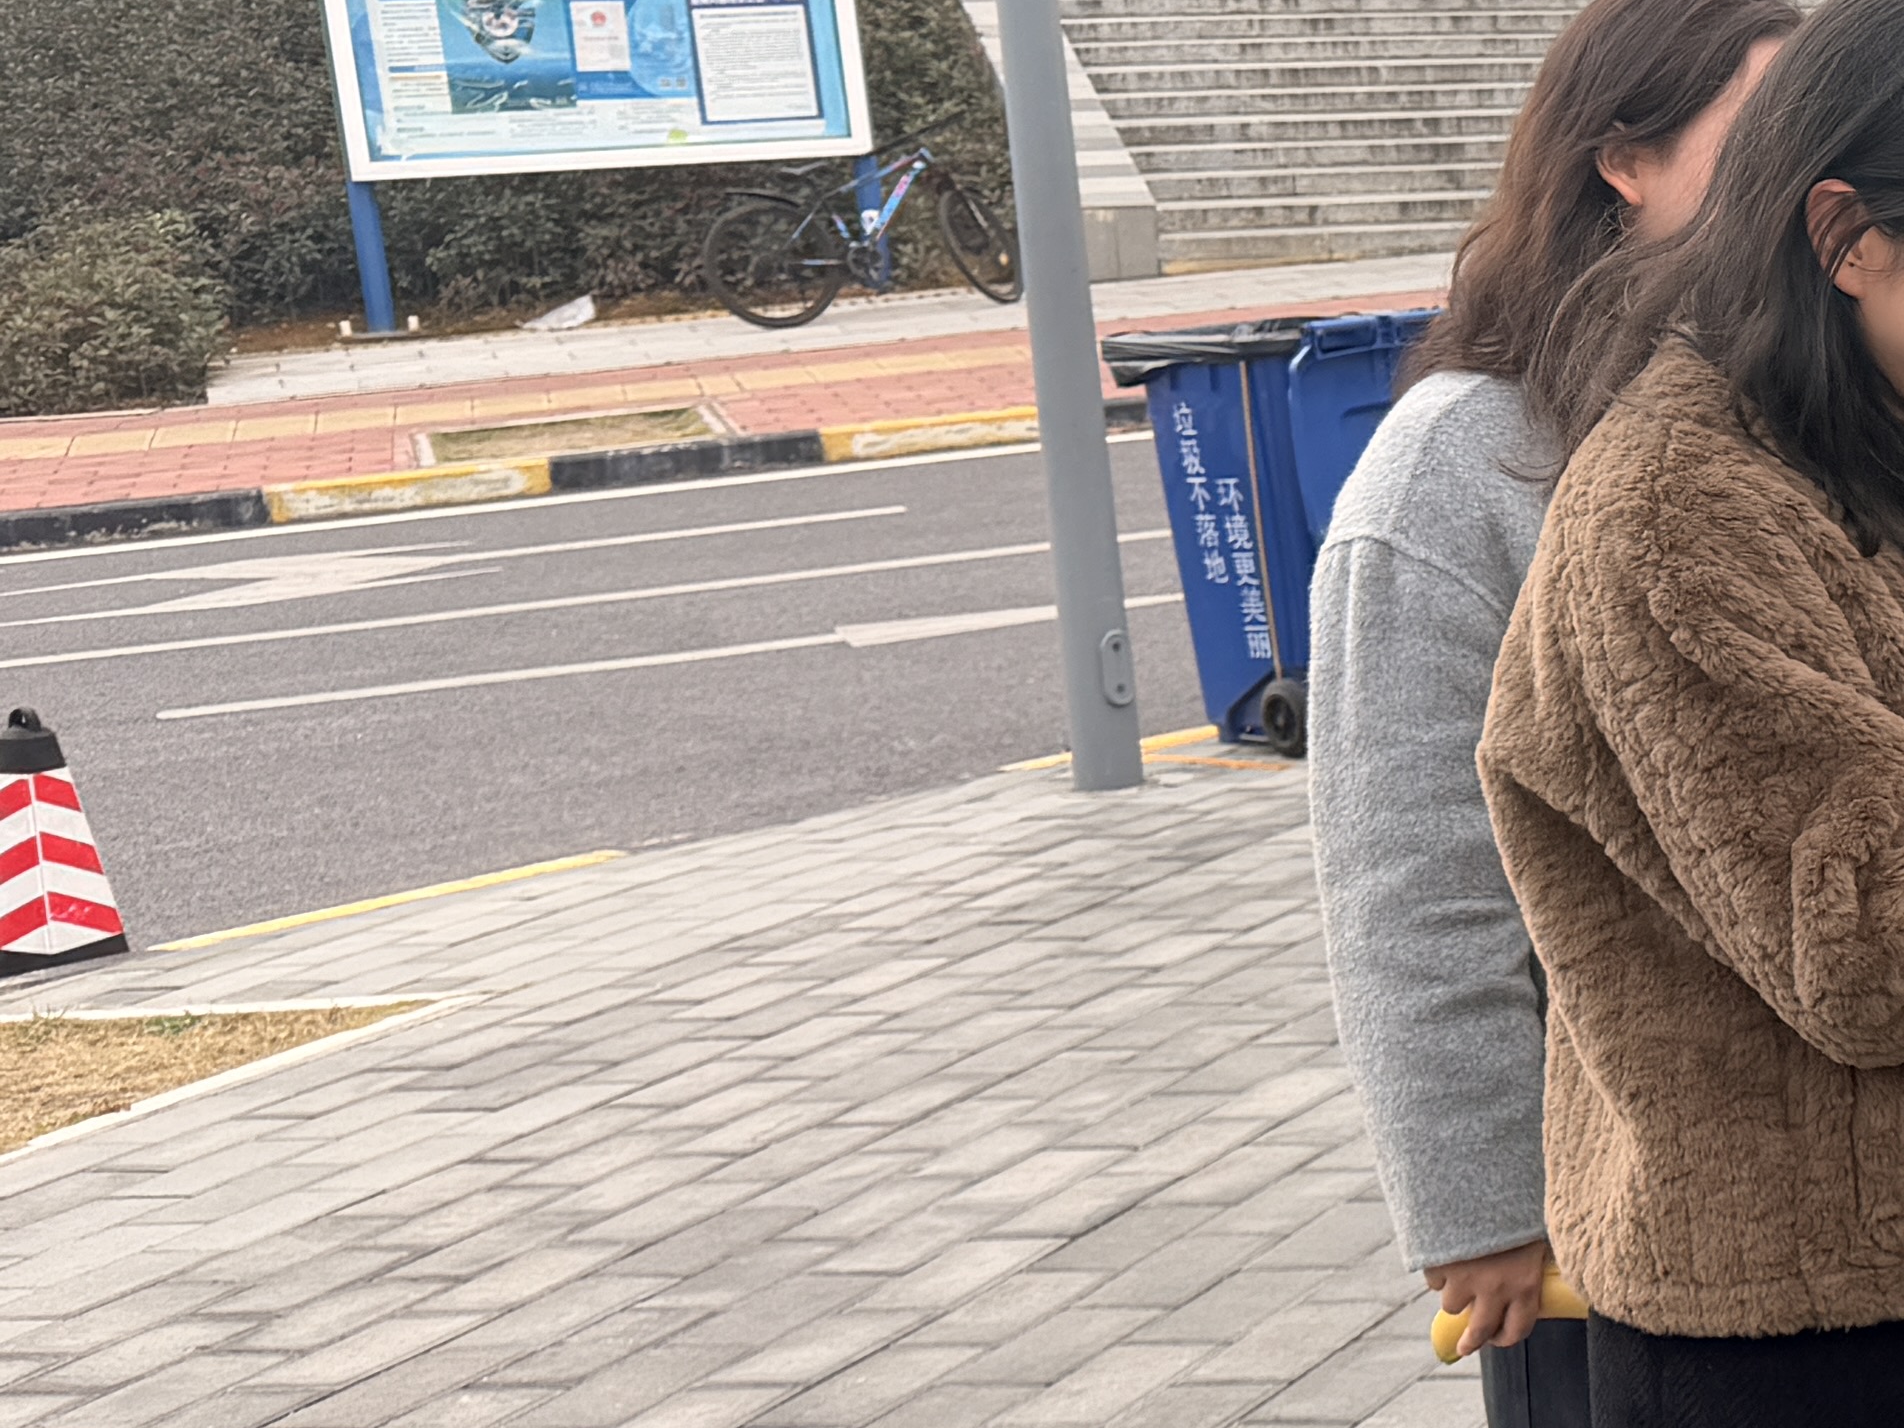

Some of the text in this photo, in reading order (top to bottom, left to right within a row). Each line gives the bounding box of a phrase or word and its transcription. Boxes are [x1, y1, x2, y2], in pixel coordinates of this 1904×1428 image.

[1172, 402, 1230, 585] 垃圾不落地
[1215, 478, 1273, 660] 环境更美丽
